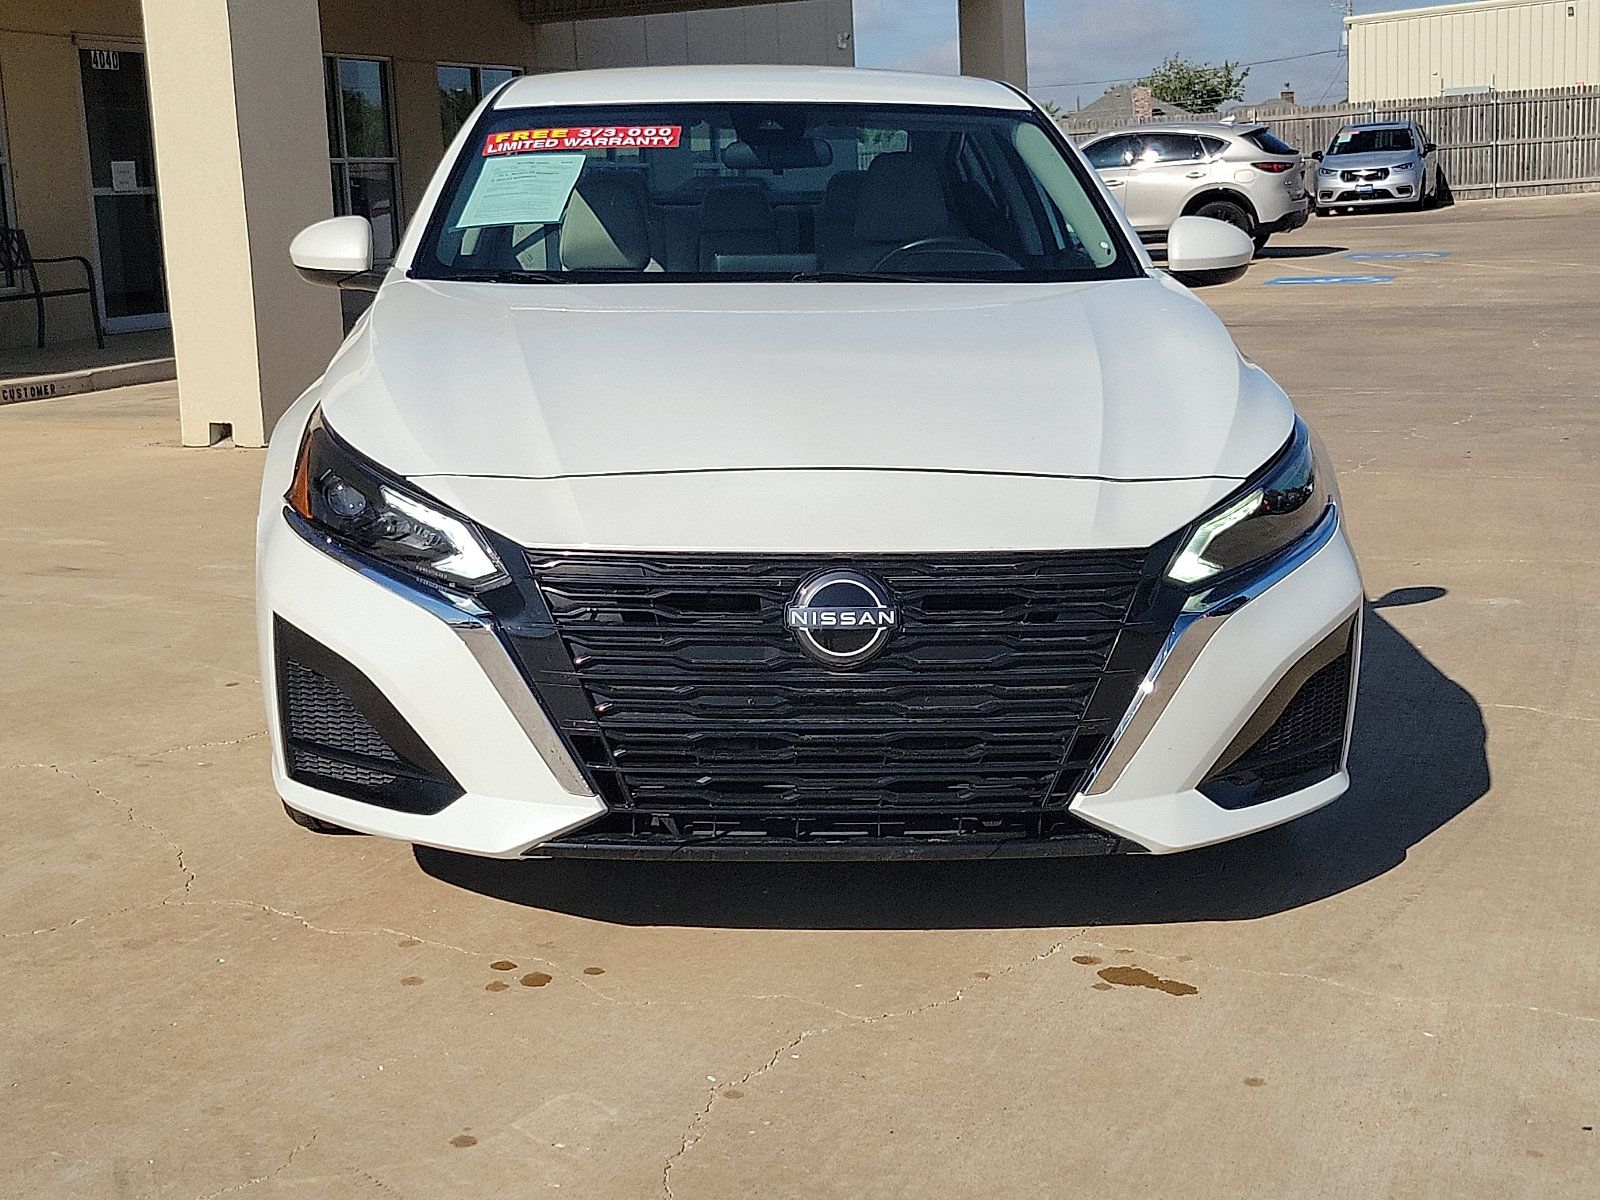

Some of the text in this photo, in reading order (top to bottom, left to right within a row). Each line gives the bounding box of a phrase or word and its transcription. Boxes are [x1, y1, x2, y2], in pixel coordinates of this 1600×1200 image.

[91, 49, 119, 69] 4040
[495, 129, 569, 144] FREE
[487, 136, 674, 154] LIMITED WARRANTY
[2, 384, 56, 400] CUSTOMER
[791, 610, 895, 626] NISSAN
